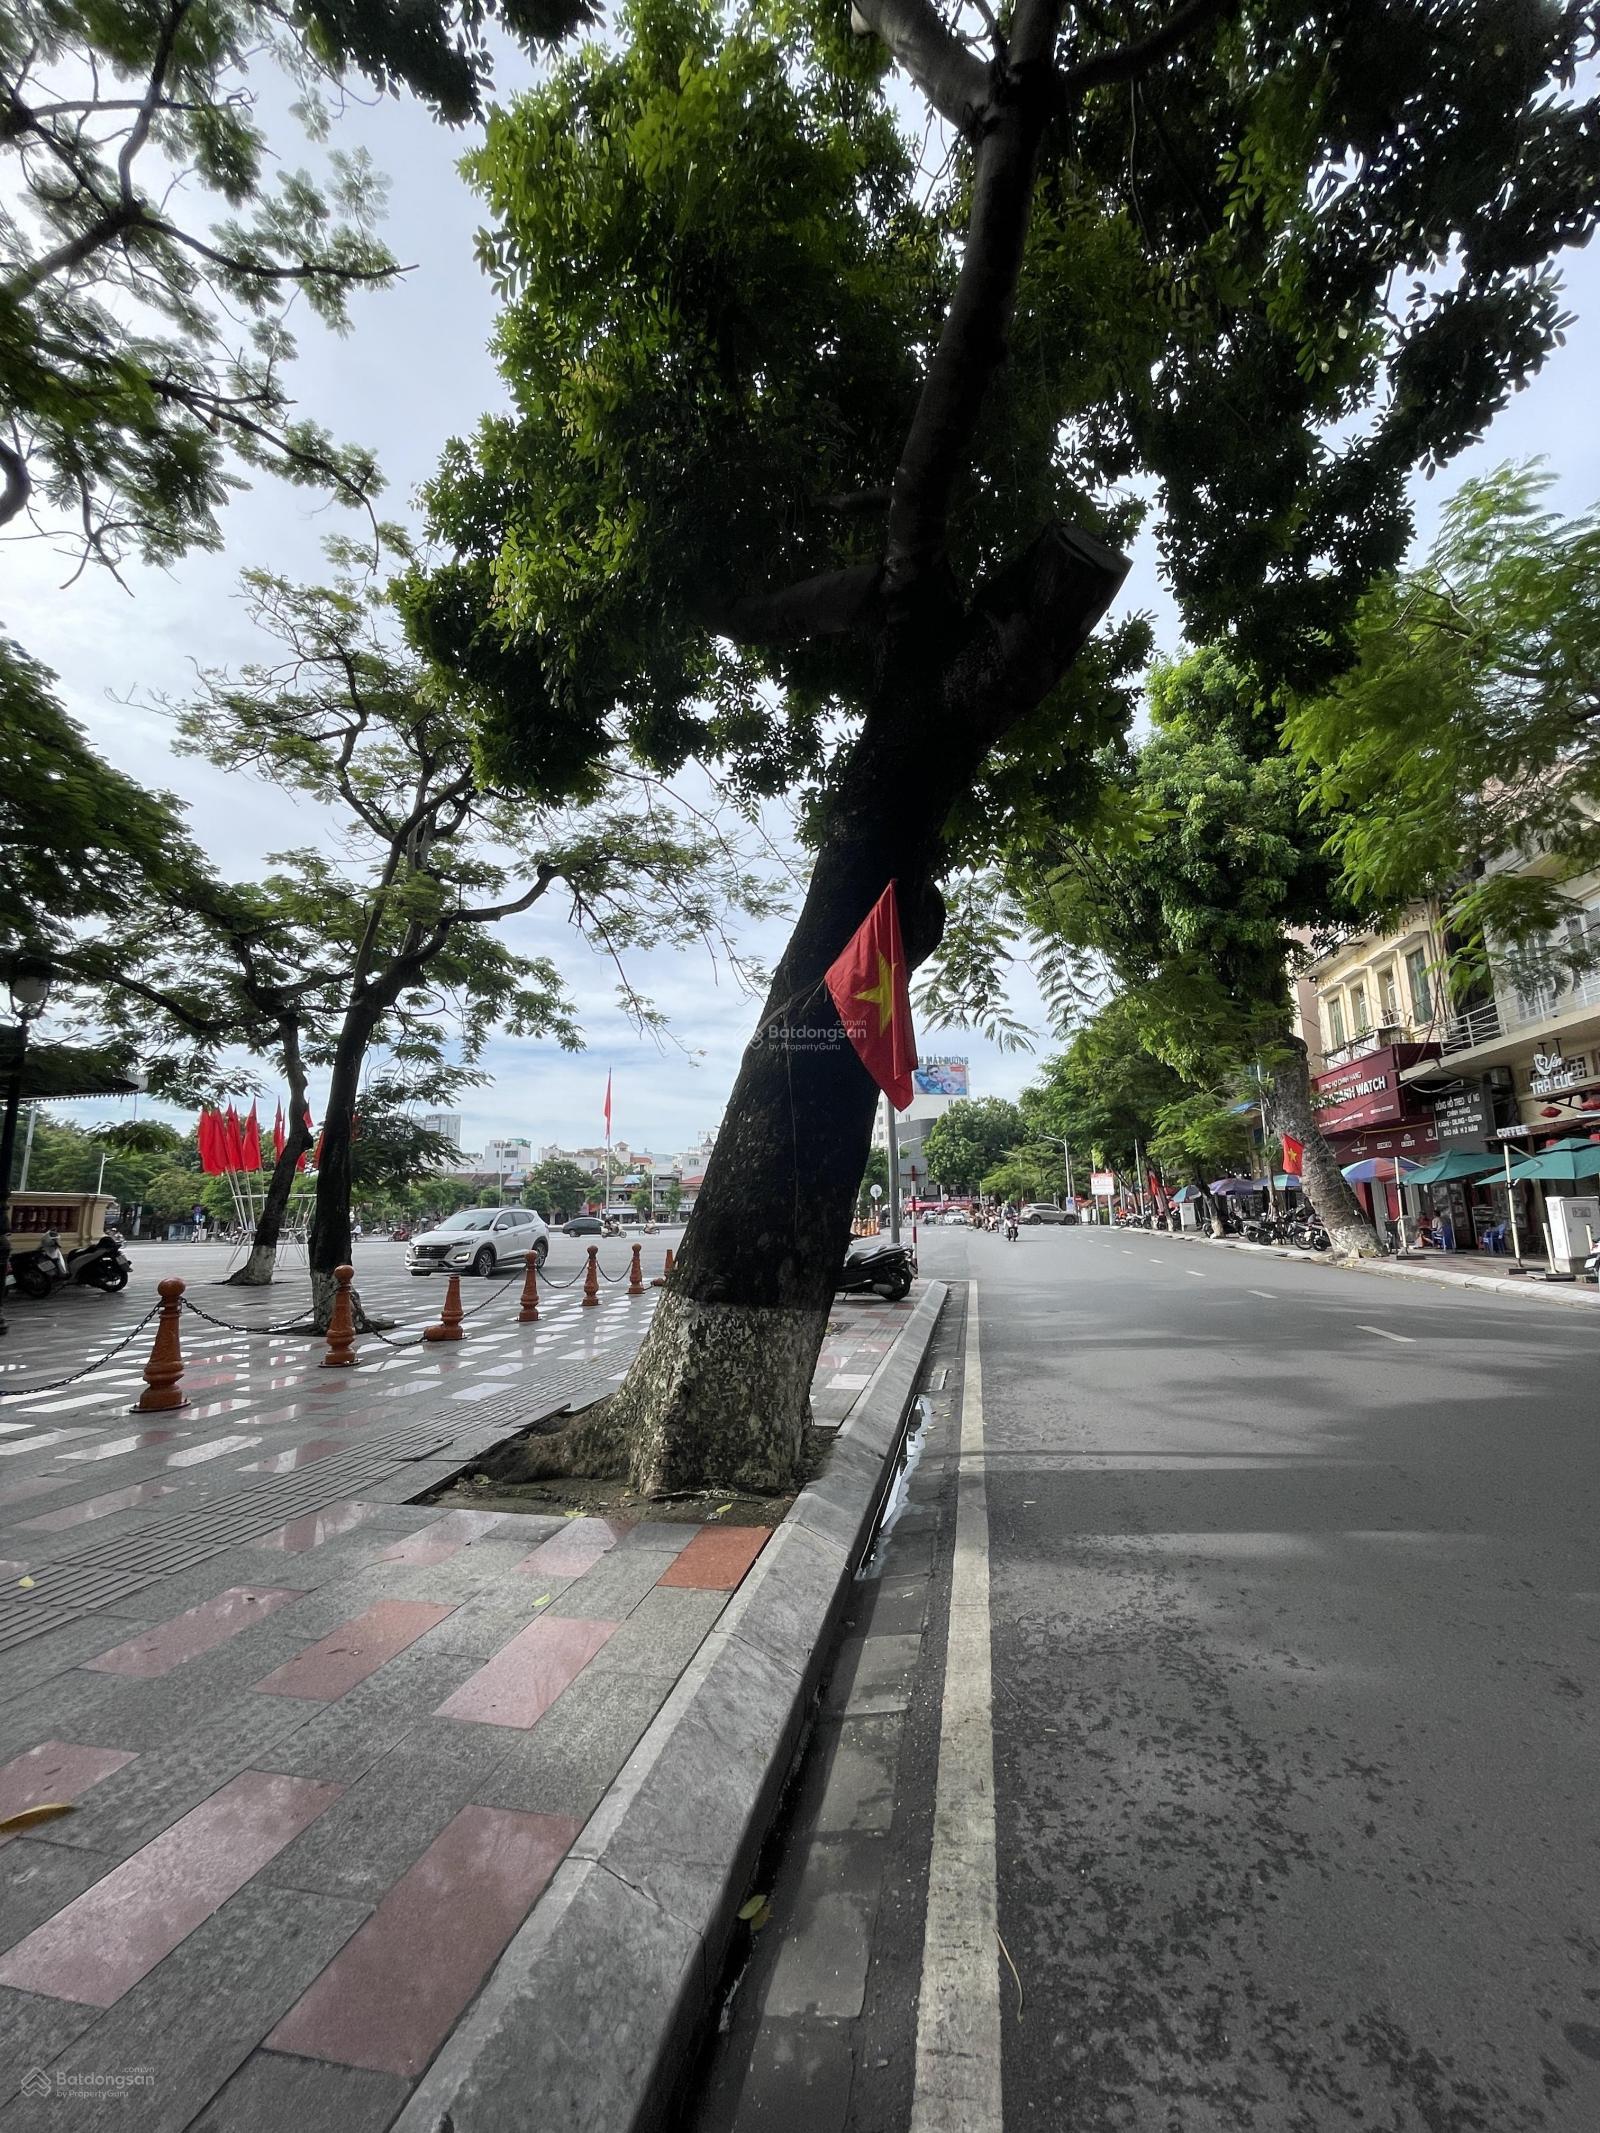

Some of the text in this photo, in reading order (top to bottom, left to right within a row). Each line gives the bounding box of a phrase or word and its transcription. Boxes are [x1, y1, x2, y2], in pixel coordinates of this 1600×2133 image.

[1356, 1075, 1386, 1096] WATCH
[1529, 1070, 1576, 1095] TRÀ CÚC
[1496, 1125, 1529, 1138] COFFEE
